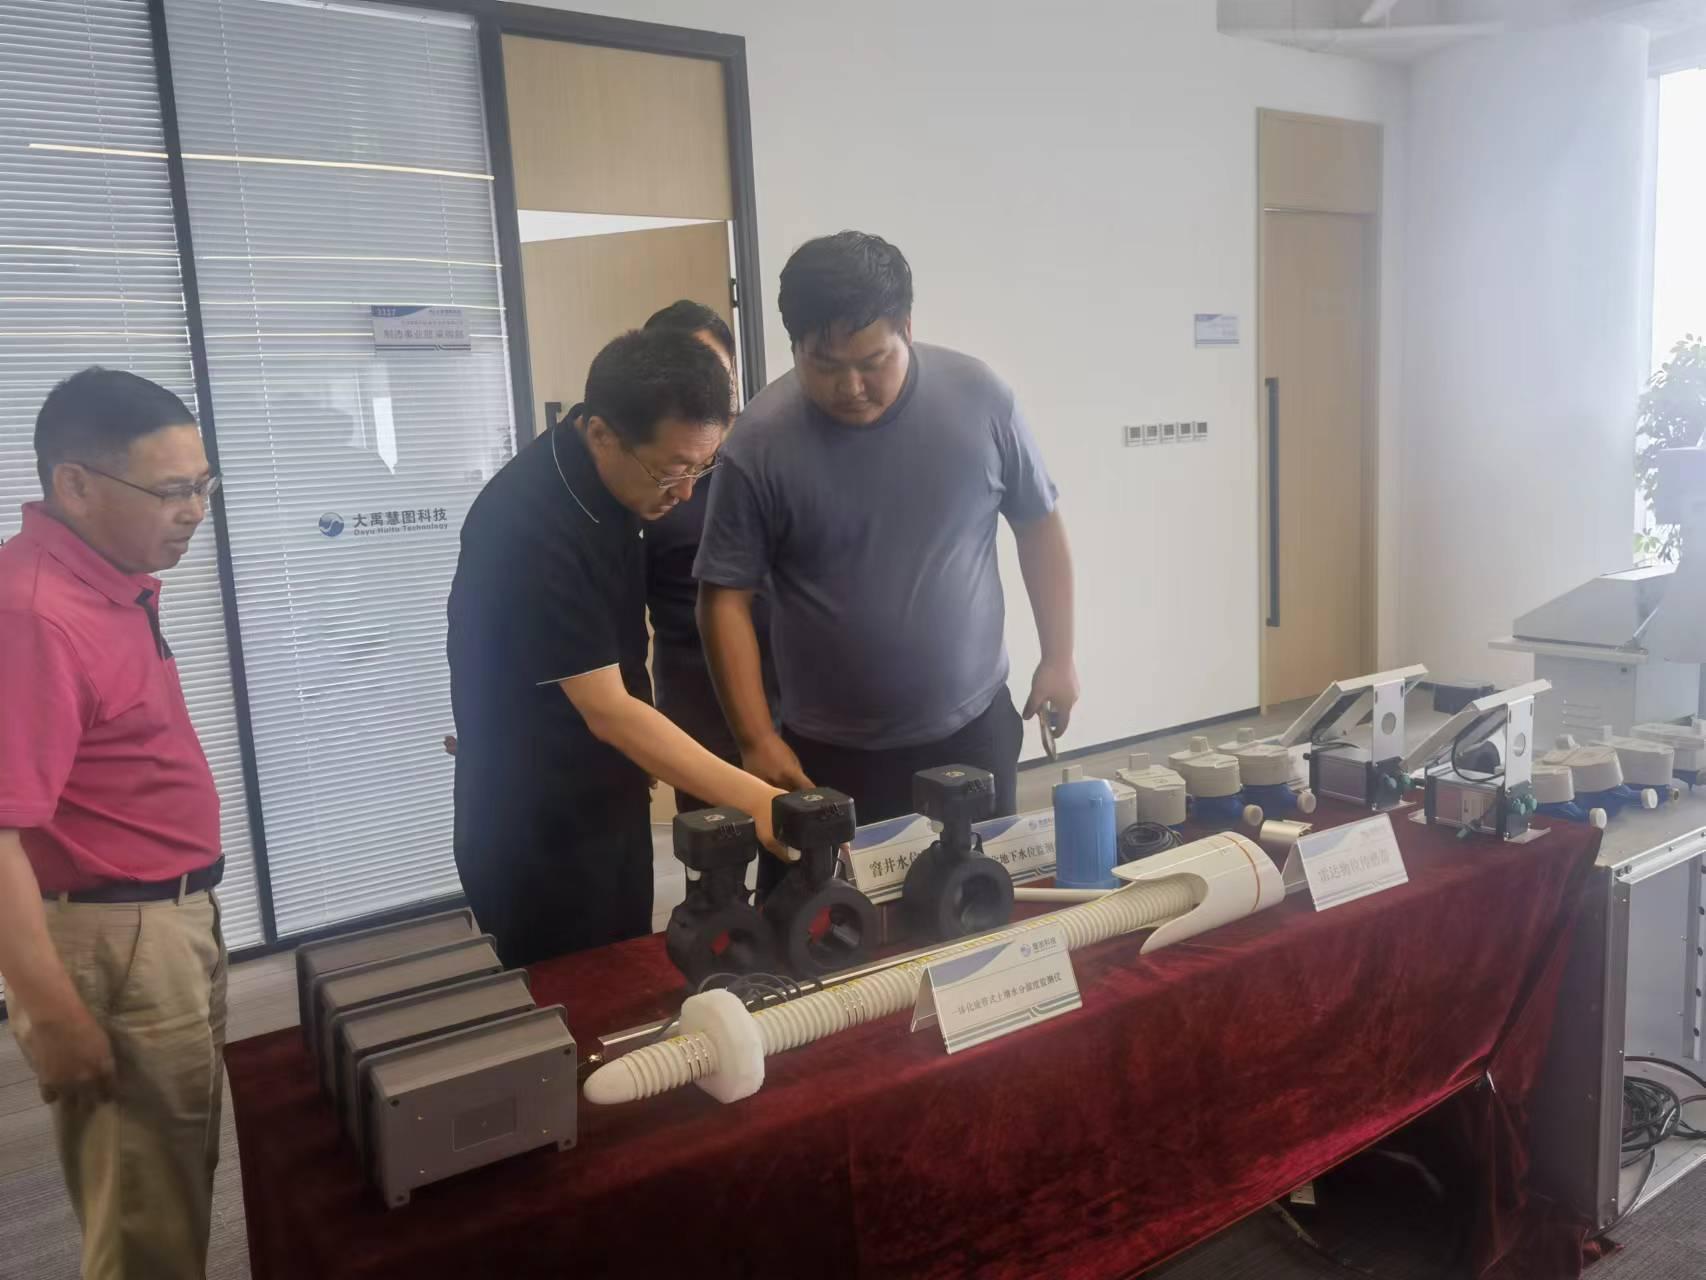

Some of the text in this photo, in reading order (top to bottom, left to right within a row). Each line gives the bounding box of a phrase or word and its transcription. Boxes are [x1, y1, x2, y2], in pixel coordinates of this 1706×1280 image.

[353, 509, 447, 528] 大禹慧图科技
[403, 523, 448, 532] Technology
